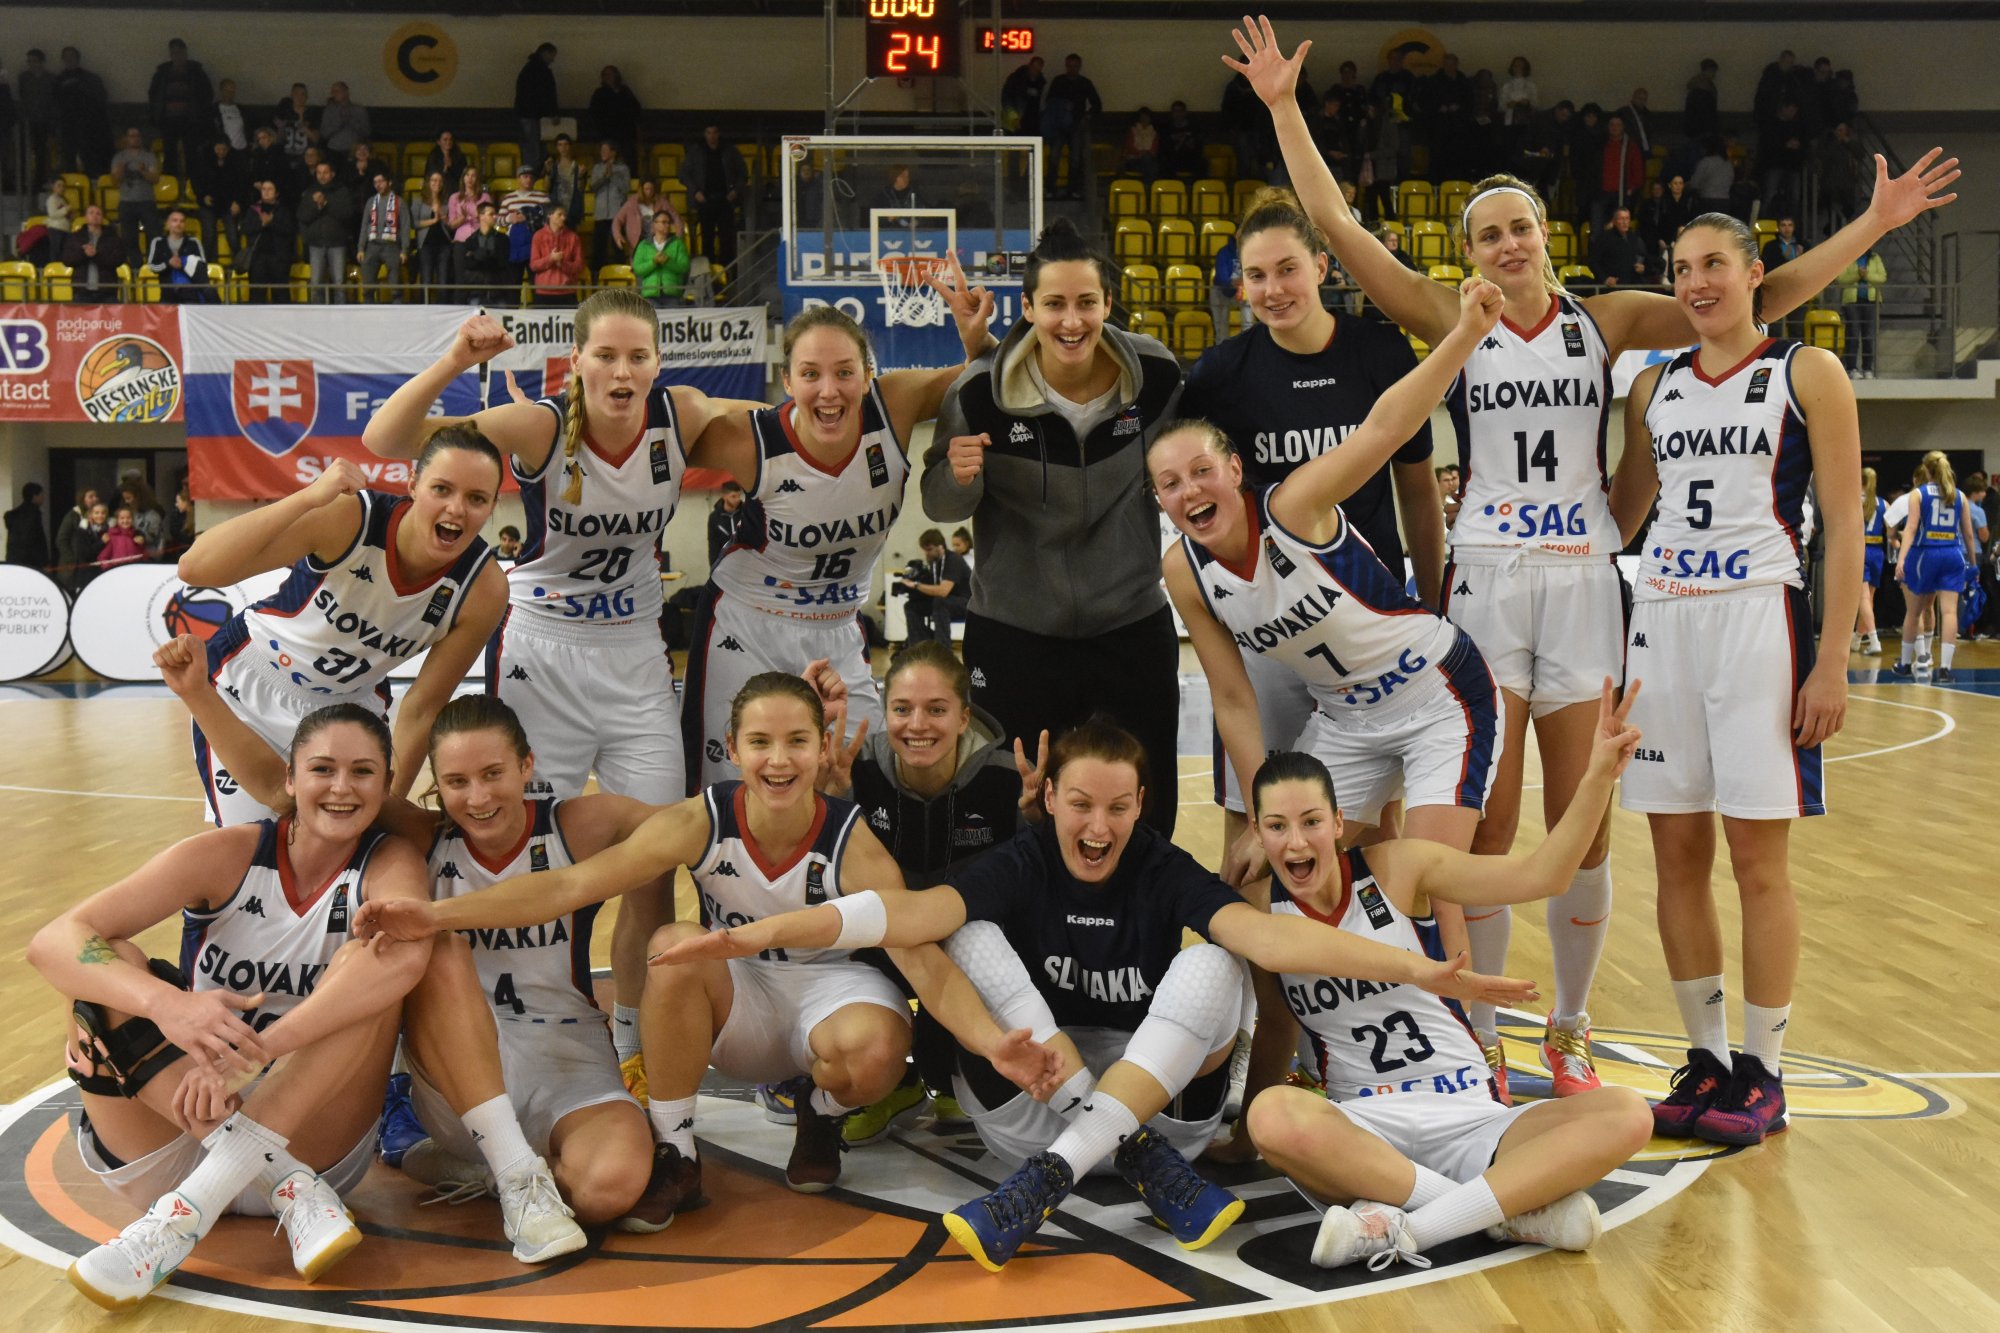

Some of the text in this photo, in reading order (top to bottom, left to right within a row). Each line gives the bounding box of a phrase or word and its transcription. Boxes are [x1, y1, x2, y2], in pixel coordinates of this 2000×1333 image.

[887, 32, 939, 71] 24
[57, 318, 122, 333] podporuje
[1568, 341, 1581, 349] FIBA
[1292, 378, 1336, 389] Kappa
[1470, 379, 1599, 413] SLOVAKIA
[1750, 386, 1764, 394] FIBA
[1010, 432, 1034, 443] Kappa
[1652, 426, 1773, 464] SLOVAKIA
[1514, 430, 1558, 483] 14
[1517, 503, 1587, 538] SAG
[1686, 480, 1714, 530] 5
[568, 546, 634, 584] 20
[811, 547, 857, 581] 16
[1675, 549, 1750, 579] SAG
[563, 584, 635, 619] SAG
[313, 647, 371, 683] 31
[1304, 642, 1350, 677] 7
[1352, 648, 1427, 704] SAG
[1066, 914, 1115, 927] Kappa
[1370, 906, 1386, 919] FIBA
[494, 973, 526, 1015] 4
[1351, 1011, 1435, 1074] 23
